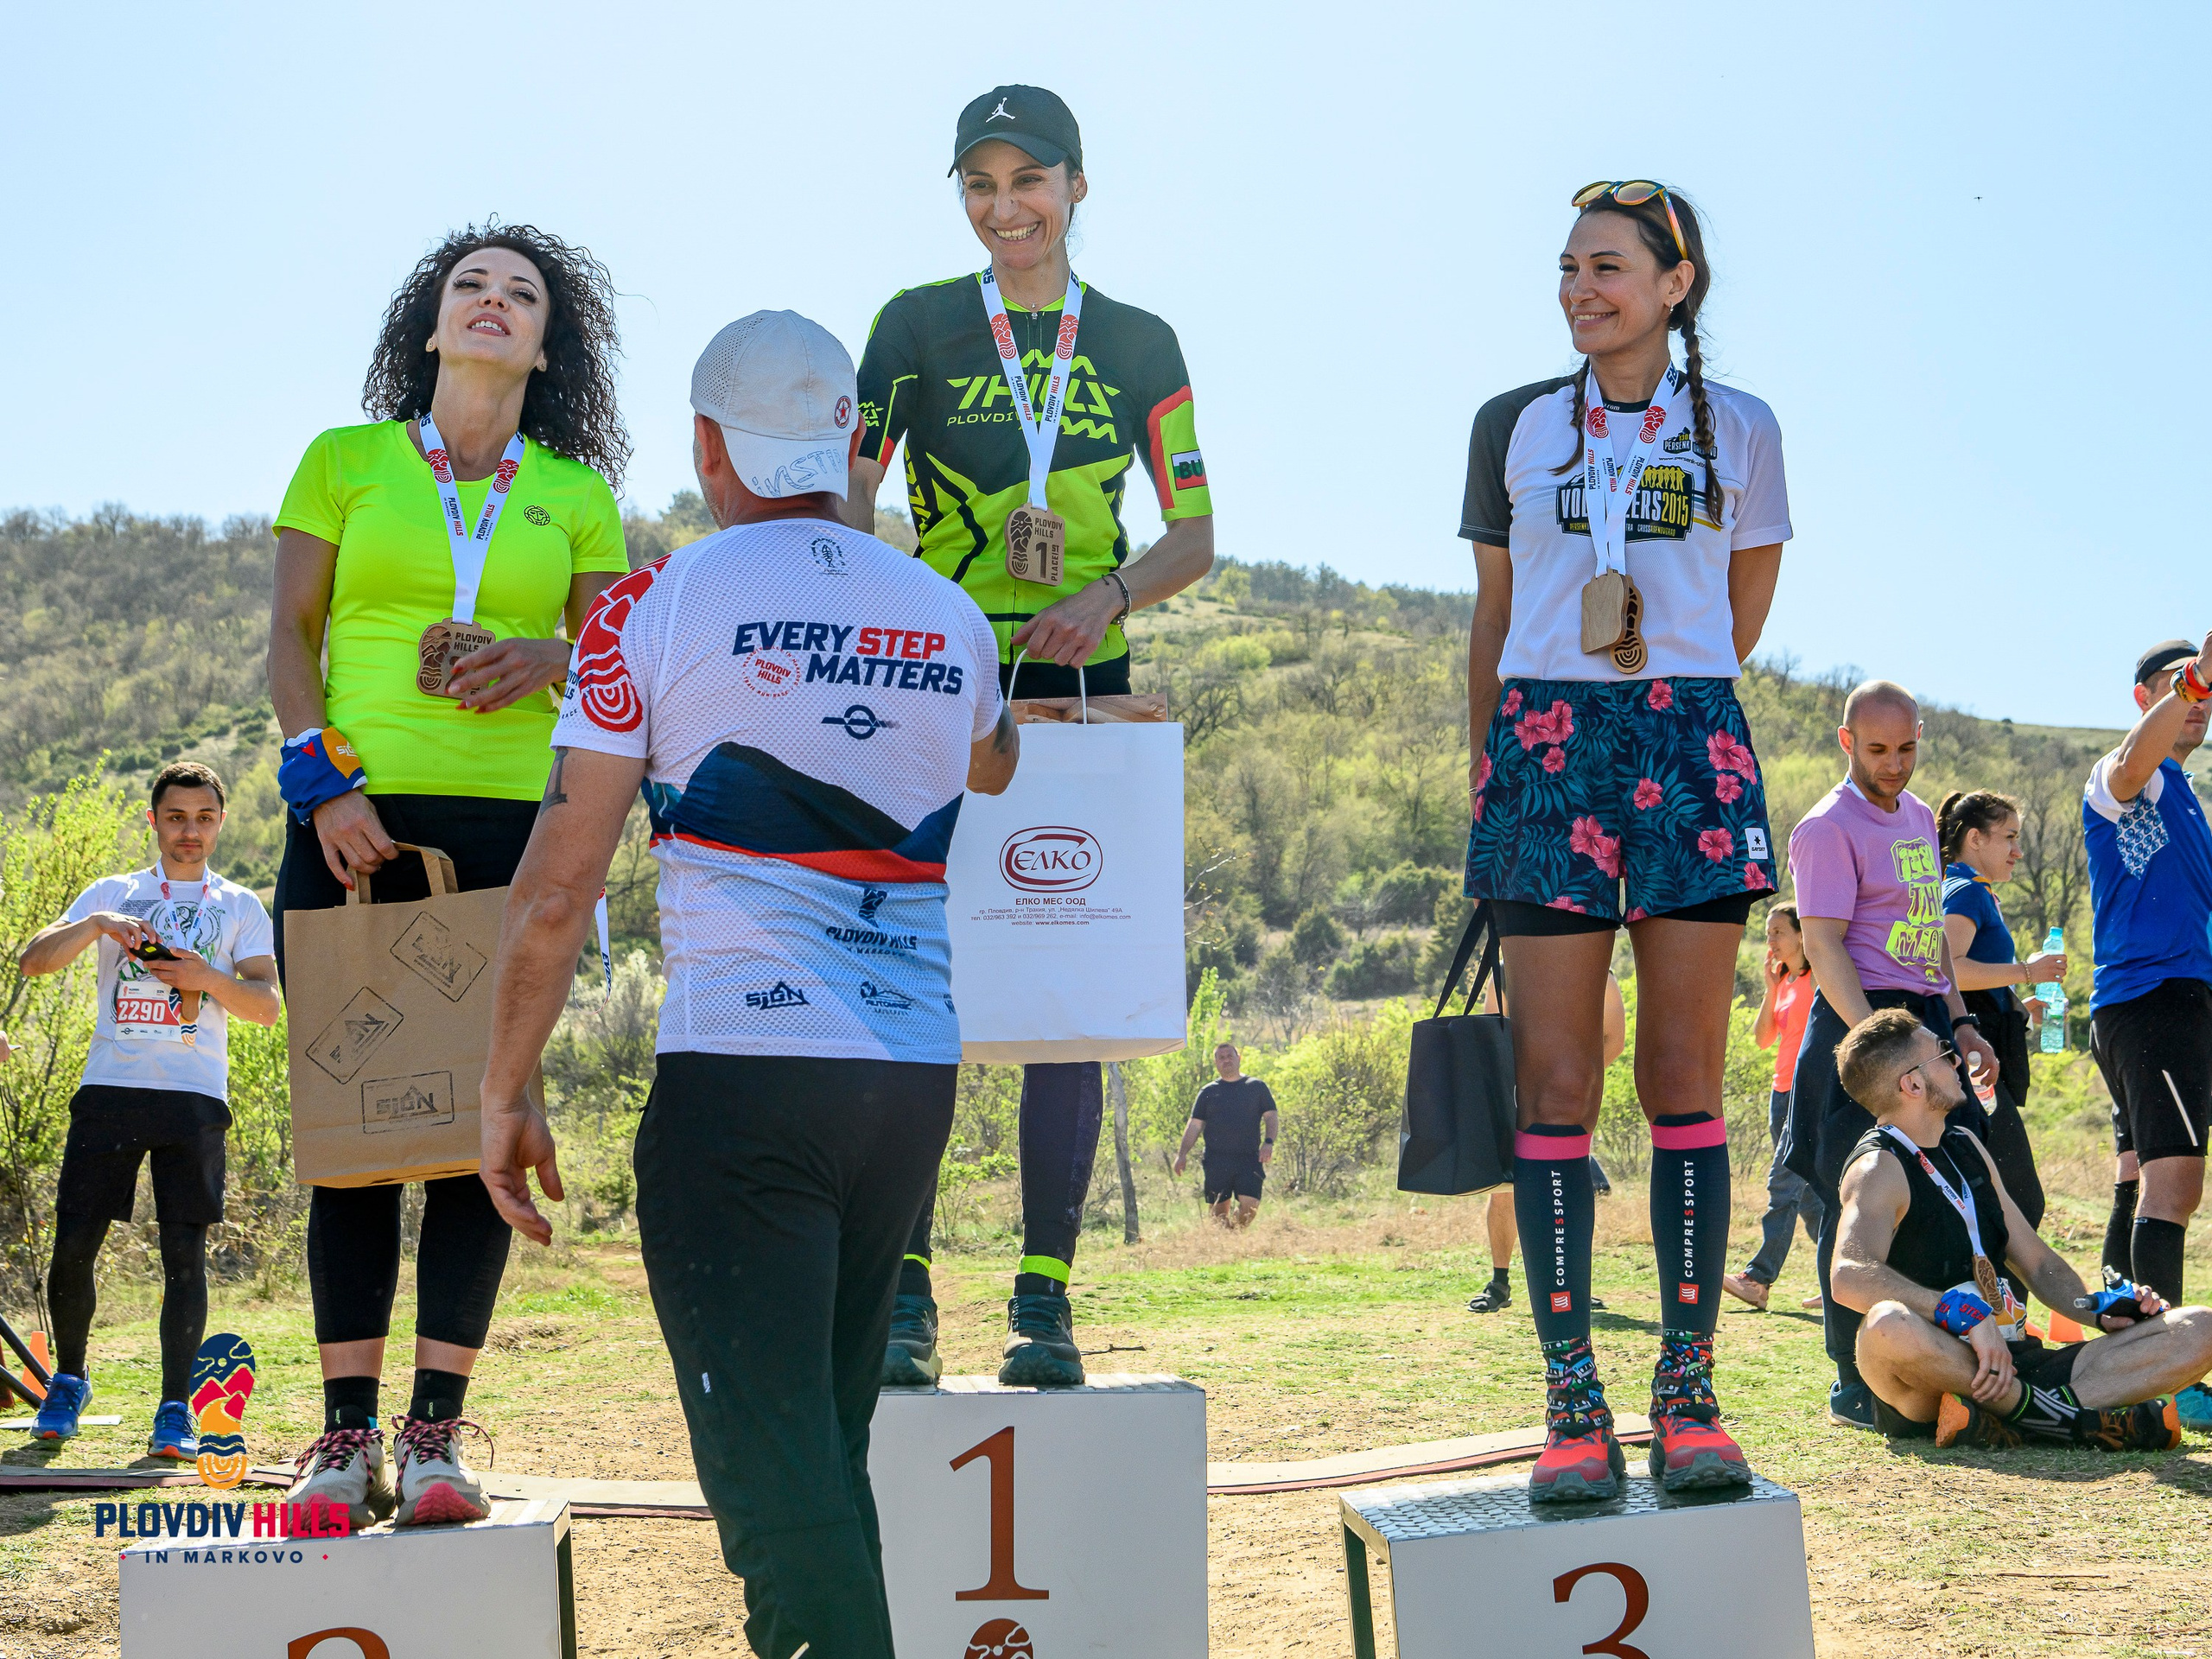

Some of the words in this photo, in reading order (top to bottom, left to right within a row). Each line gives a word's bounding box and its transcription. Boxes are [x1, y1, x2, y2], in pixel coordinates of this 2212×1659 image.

[1051, 375, 1060, 394] HILLS
[1022, 403, 1033, 421] HILLS
[1664, 440, 1690, 450] PERSENK
[1625, 478, 1637, 496] HILLS
[484, 503, 495, 518] HILLS
[454, 520, 464, 537] HILLS
[1034, 526, 1054, 539] HILLS
[1035, 518, 1063, 531] PLOVDIV
[1035, 542, 1047, 579] 1
[455, 632, 493, 645] PLOVDIV
[732, 621, 855, 656] EVERY
[855, 627, 945, 660] STEP
[754, 658, 792, 678] PLOVDIV
[805, 654, 963, 695] MATTERS
[757, 670, 783, 685] HILLS
[1065, 897, 1086, 906] ООД
[826, 925, 888, 945] PLOVDIV
[118, 1001, 166, 1022] 2290
[1683, 1160, 1694, 1278] COMPRESSPORT
[1551, 1170, 1565, 1287] COMPRESSPORT
[1959, 1303, 1986, 1321] STEP
[949, 1425, 1050, 1602] 1
